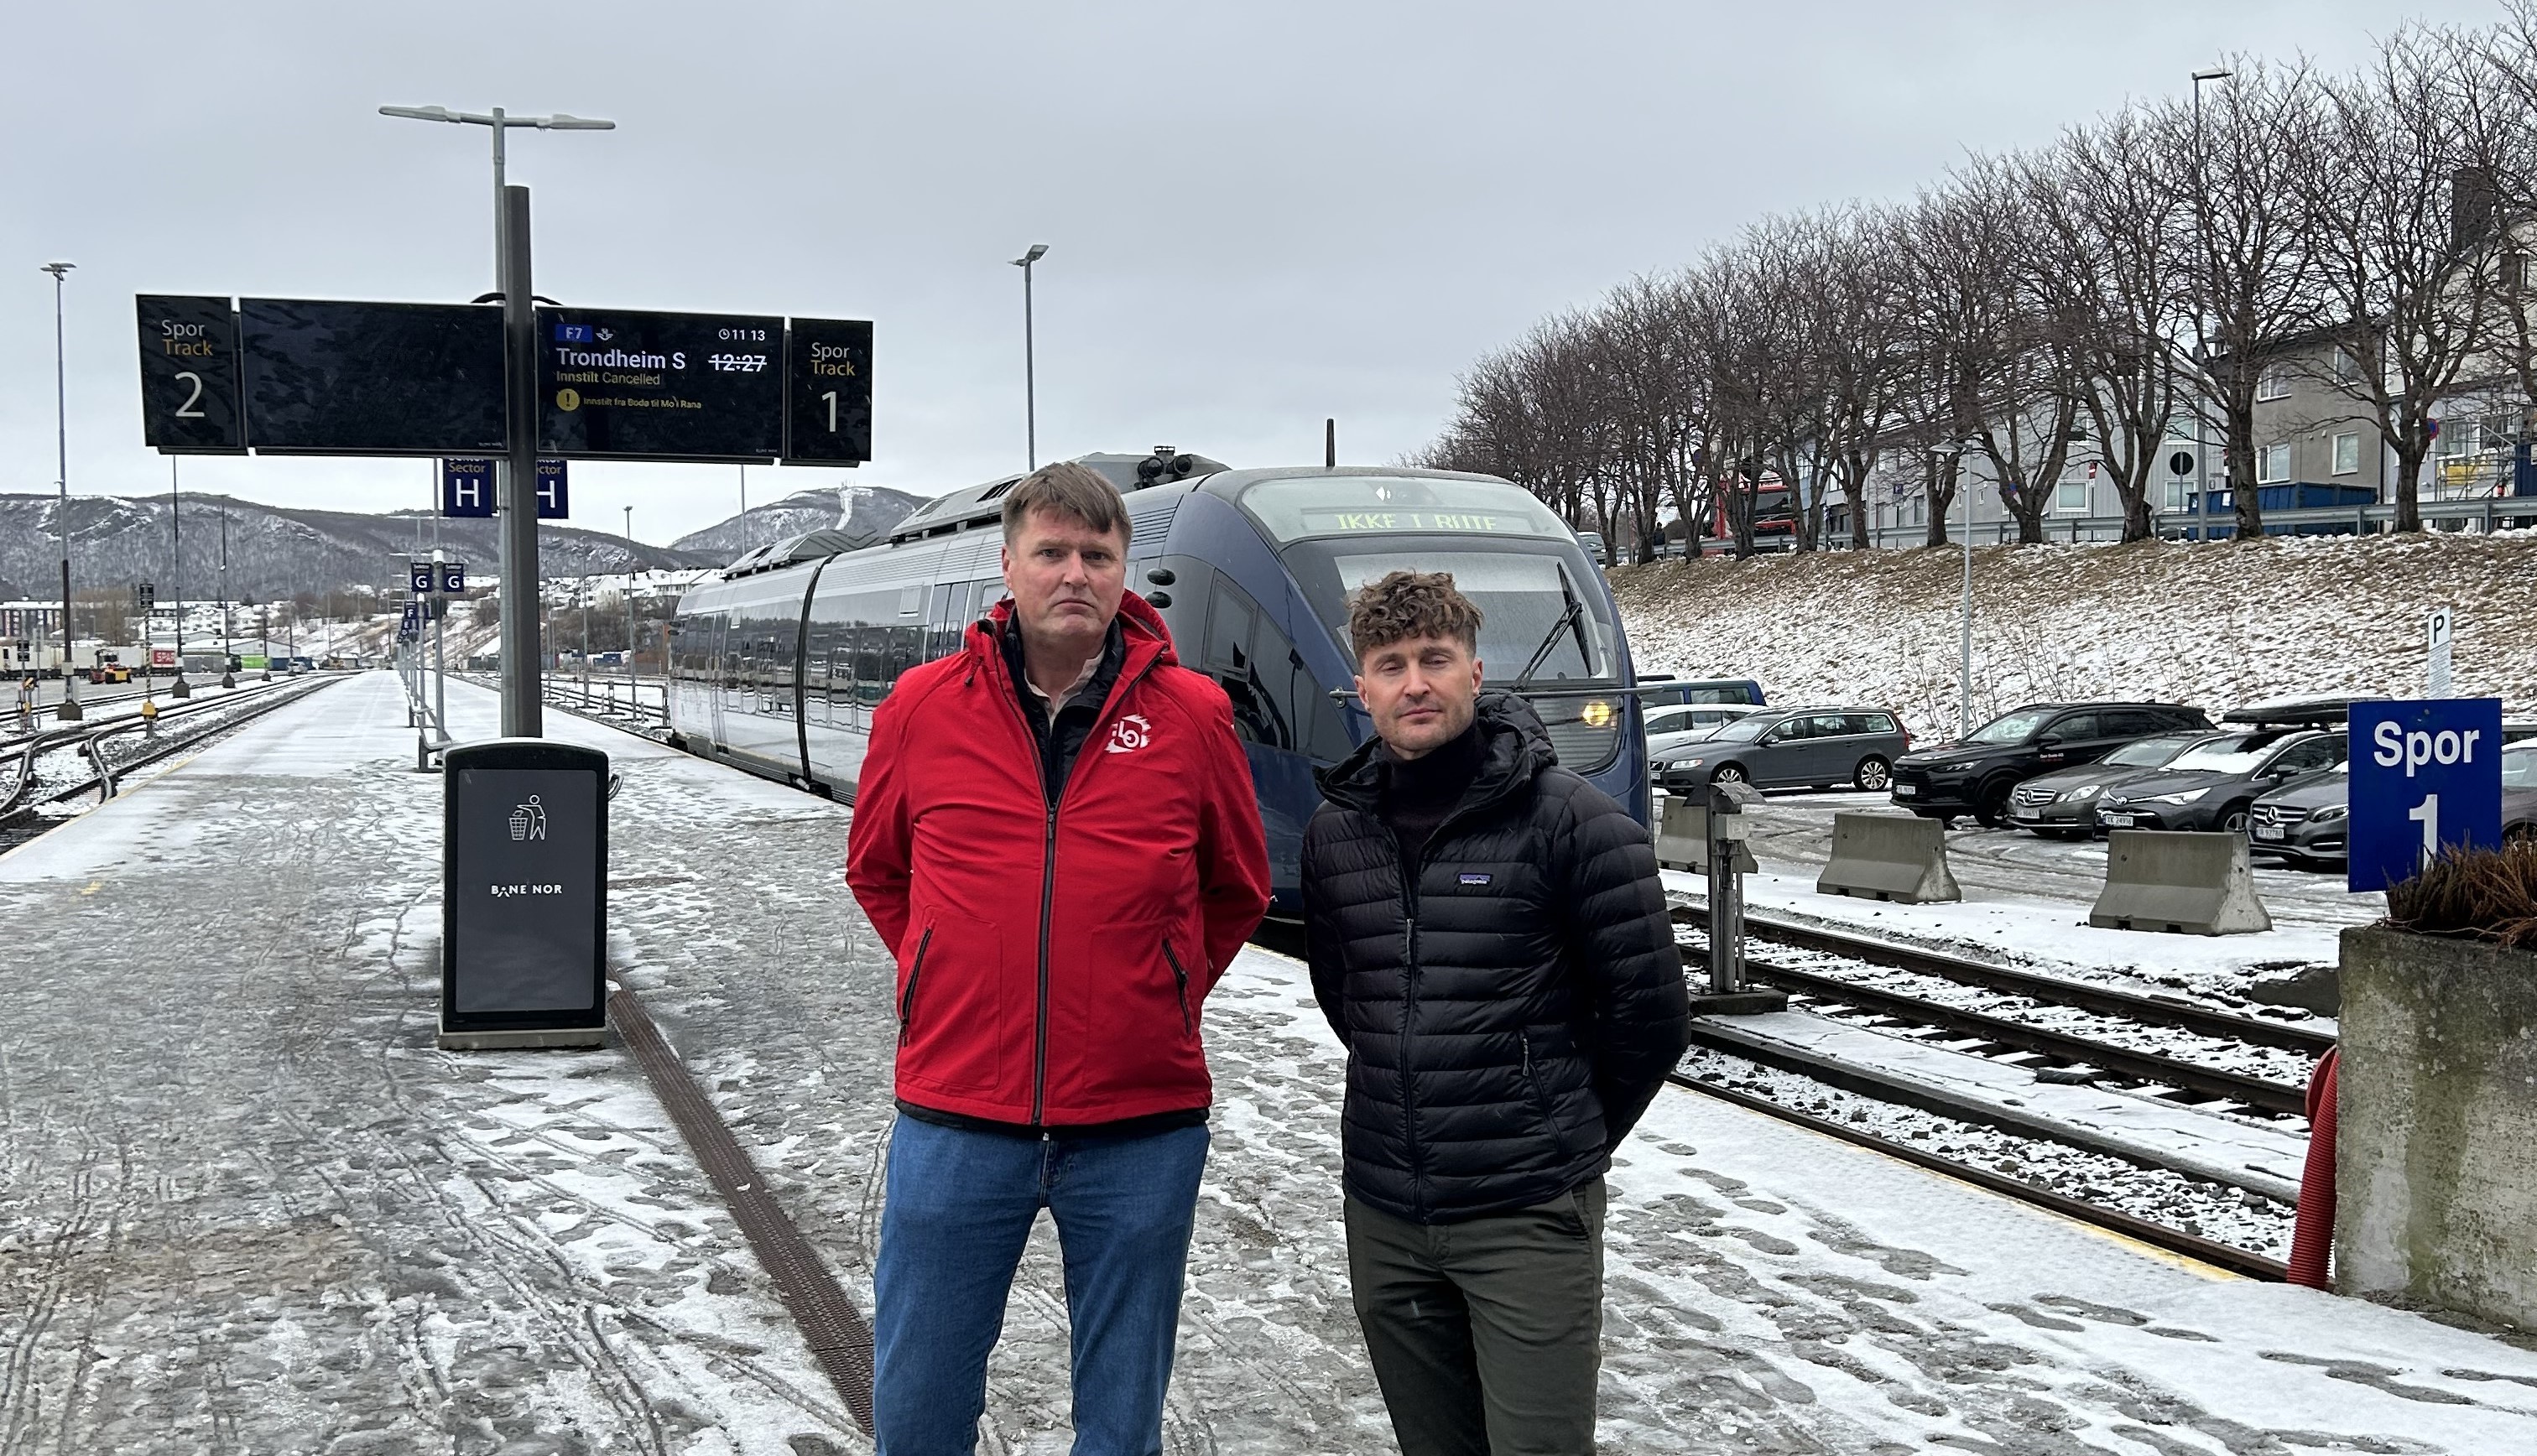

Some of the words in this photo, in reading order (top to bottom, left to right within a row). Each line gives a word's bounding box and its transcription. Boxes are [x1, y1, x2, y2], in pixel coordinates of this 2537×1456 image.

[162, 319, 206, 339] Spor
[565, 326, 583, 340] F7
[162, 339, 213, 356] Track
[811, 342, 850, 361] Spor
[555, 348, 666, 369] Trondheim
[672, 352, 685, 370] S
[709, 354, 767, 372] 12:27
[810, 360, 856, 376] Track
[556, 371, 599, 383] Innstilt
[602, 372, 660, 385] Cancelled
[175, 372, 205, 417] 2
[614, 398, 626, 406] fra
[660, 399, 675, 408] Mo
[680, 399, 701, 408] Rana
[821, 391, 836, 432] 1
[448, 462, 486, 473] Sector
[537, 465, 562, 475] ctor
[456, 478, 480, 507] H
[415, 575, 428, 588] G
[447, 575, 460, 588] G
[2434, 615, 2445, 643] P
[2373, 720, 2480, 777] Spor
[2409, 794, 2438, 871] 1
[532, 884, 562, 894] NOR
